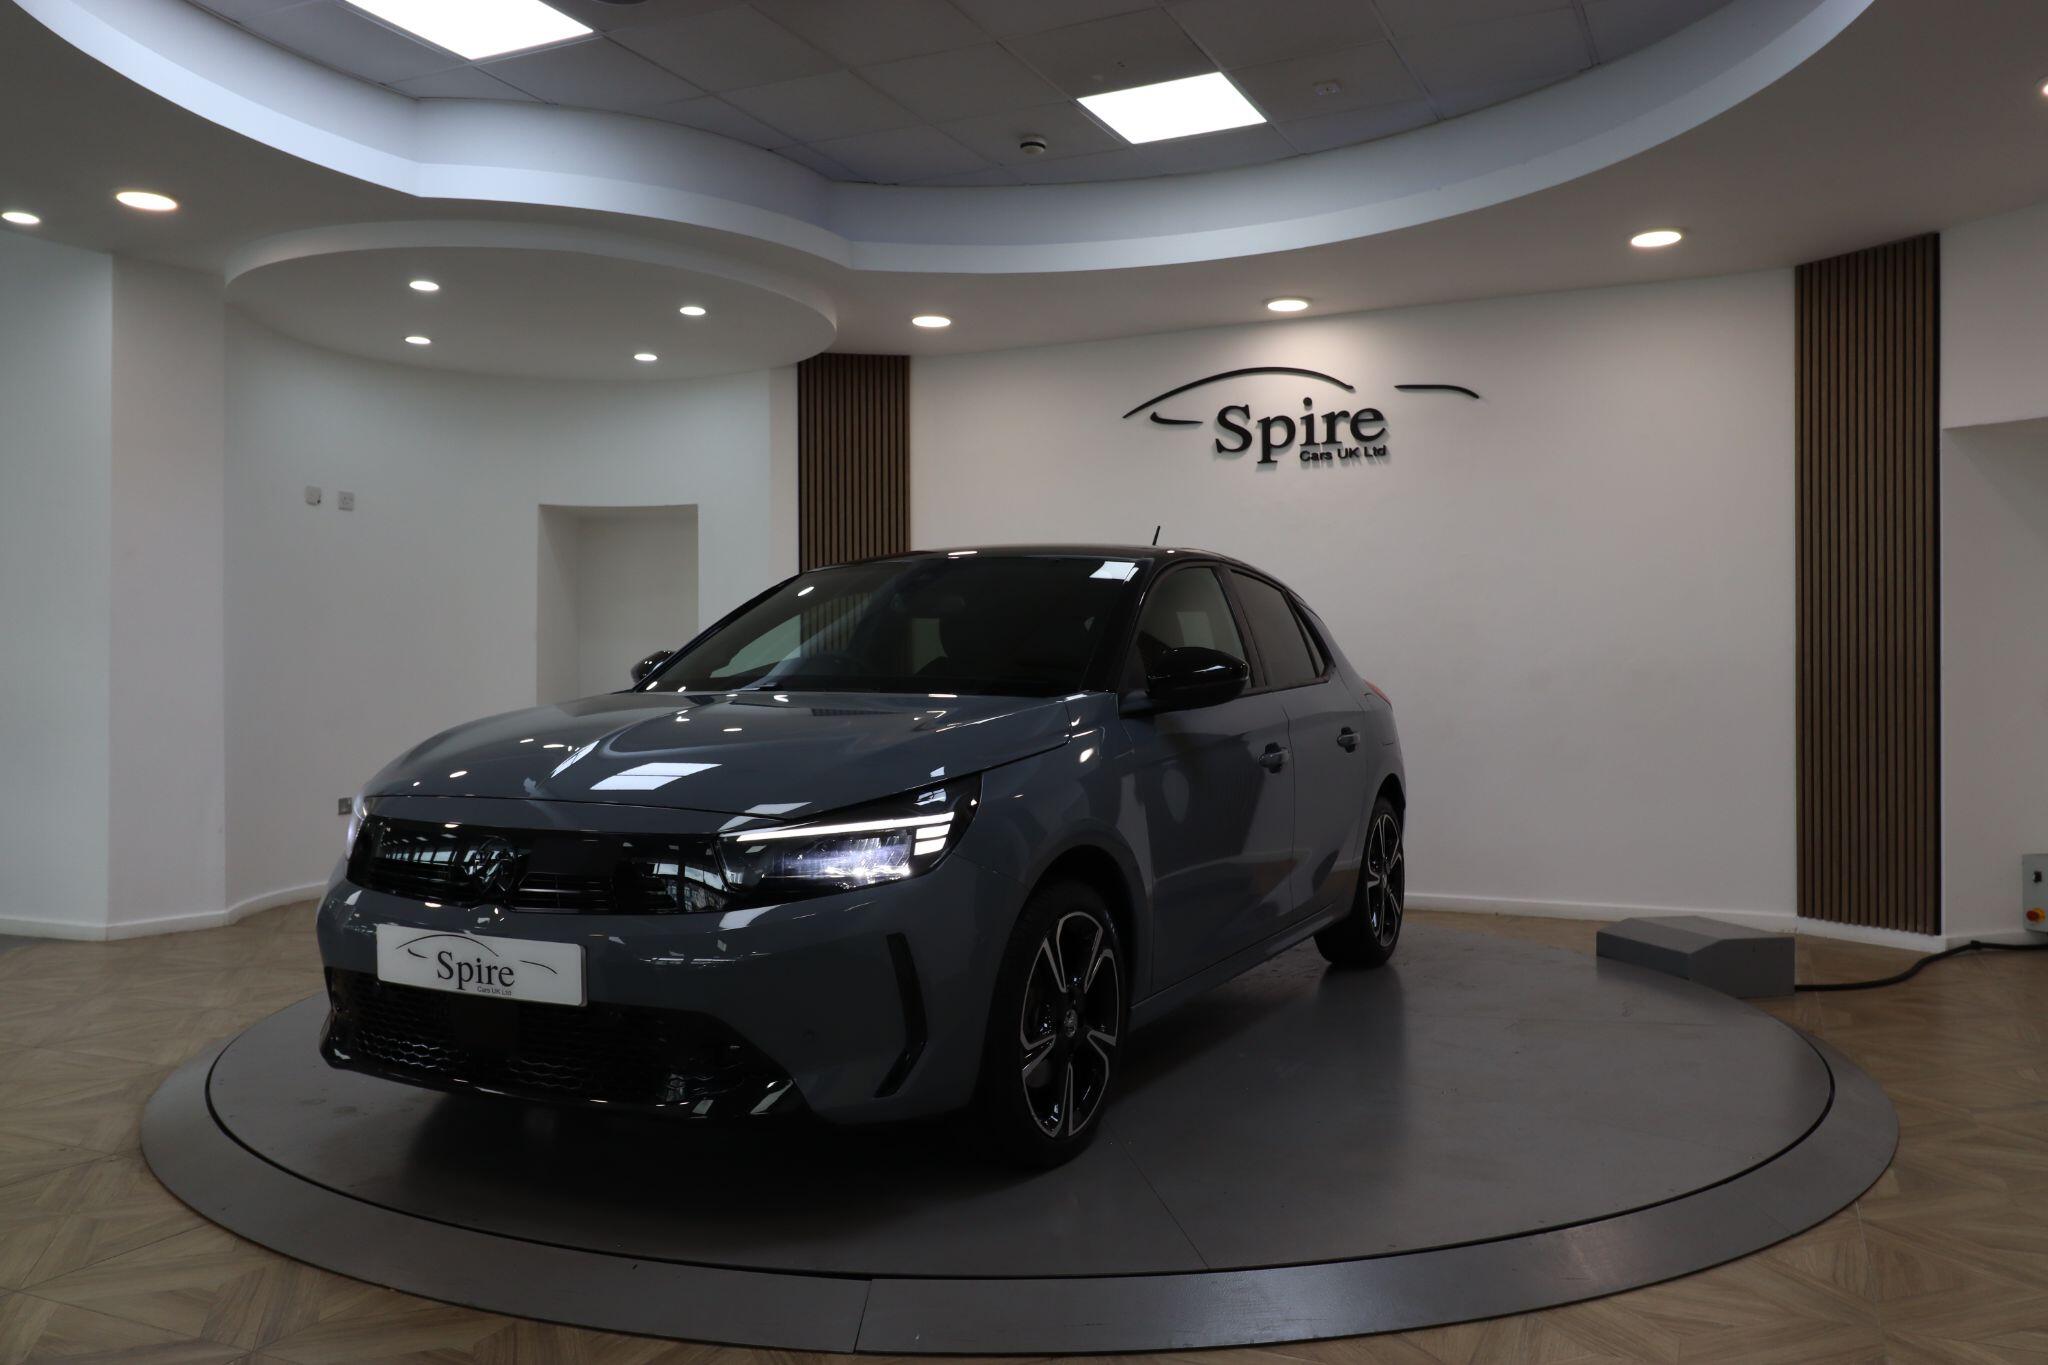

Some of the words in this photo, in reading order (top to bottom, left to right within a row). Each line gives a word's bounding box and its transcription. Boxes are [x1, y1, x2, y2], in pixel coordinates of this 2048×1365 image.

[1214, 396, 1386, 464] Spire
[1299, 450, 1333, 462] Cars
[1337, 446, 1360, 459] UK
[1363, 445, 1387, 457] Ltd
[437, 951, 515, 990] Spire
